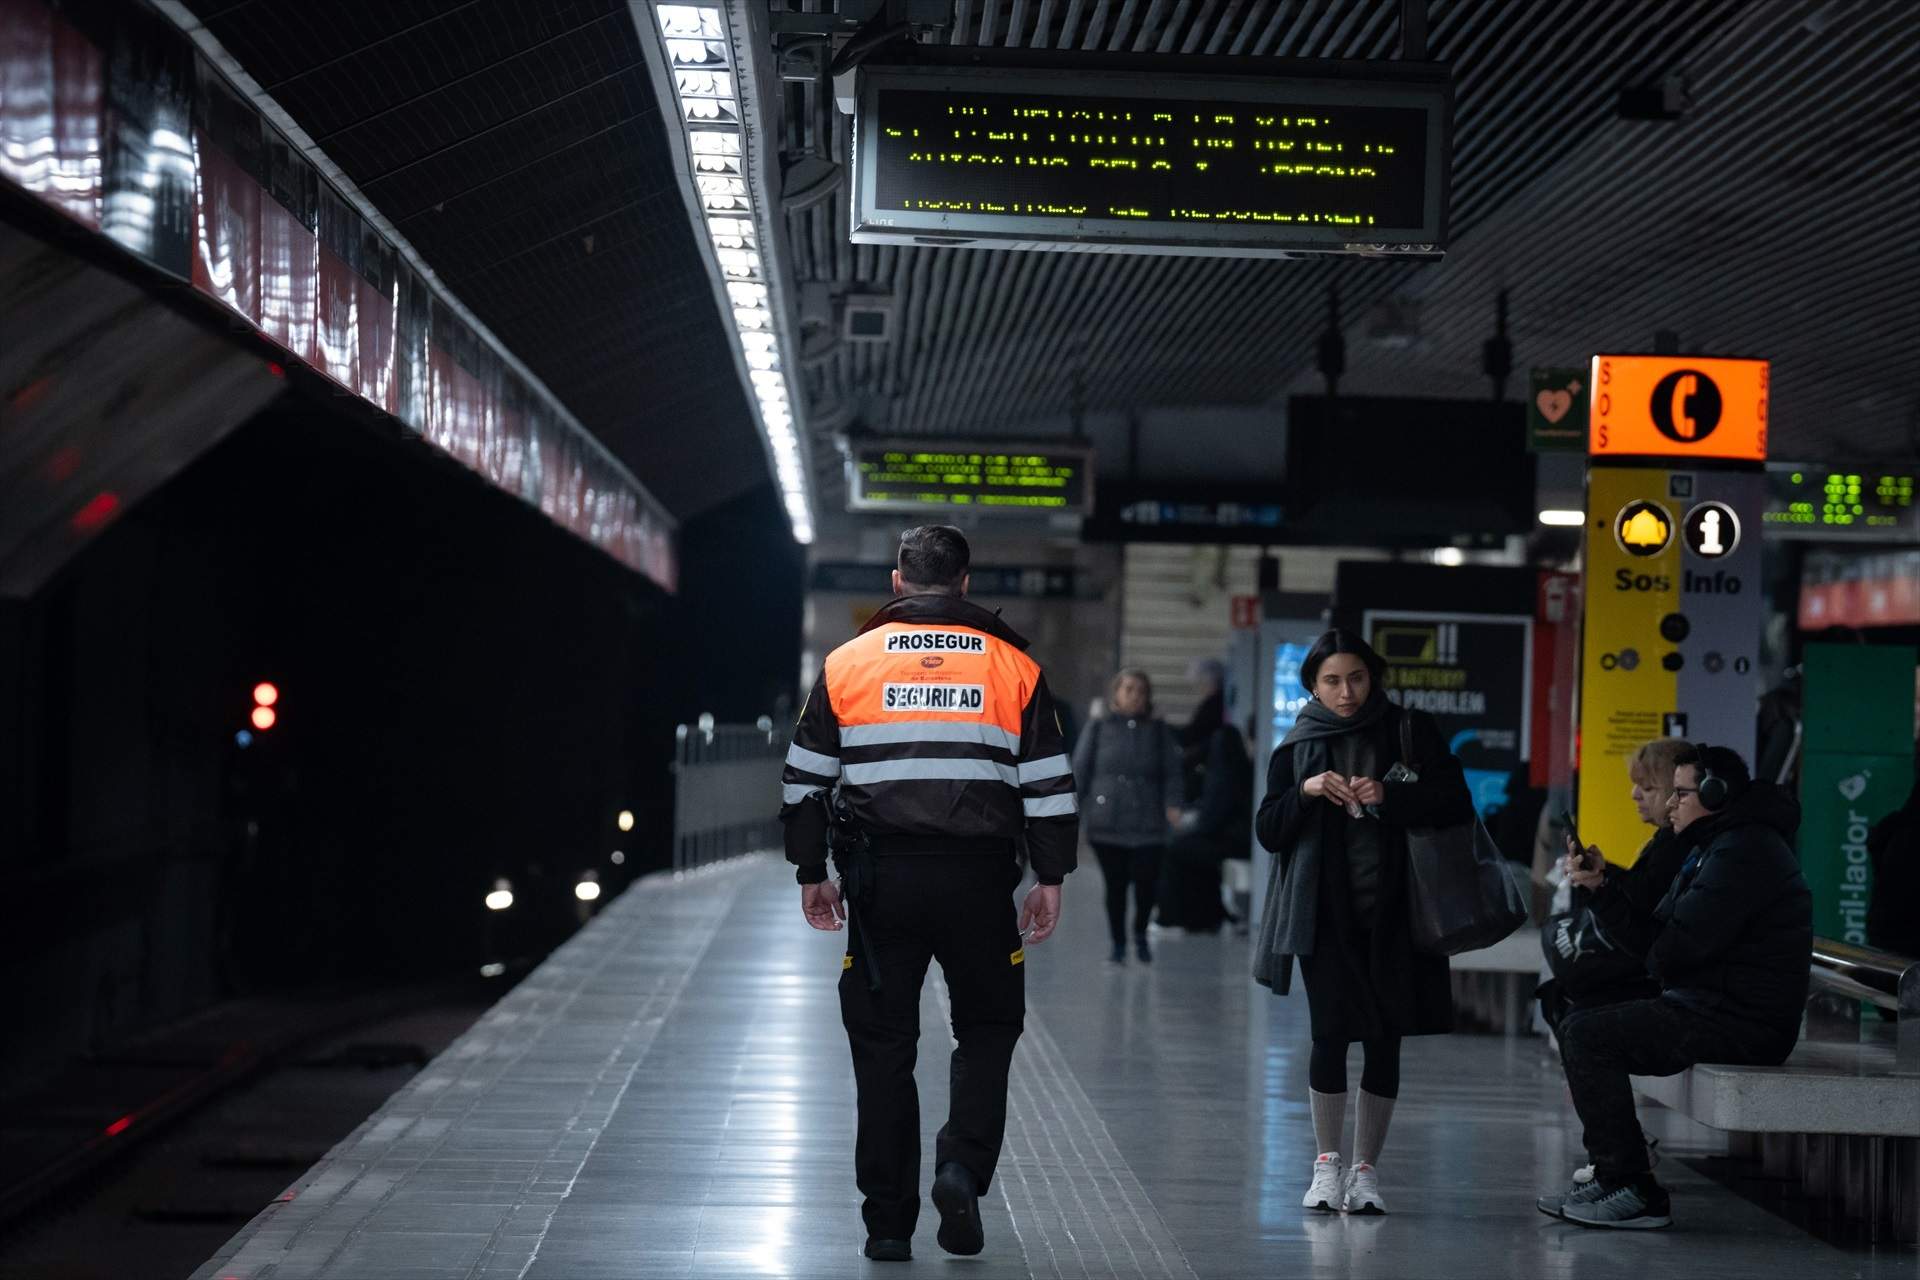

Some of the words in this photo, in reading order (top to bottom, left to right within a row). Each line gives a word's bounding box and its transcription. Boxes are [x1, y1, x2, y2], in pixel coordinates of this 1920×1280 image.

[1598, 361, 1611, 449] SOS
[1615, 567, 1671, 592] Sos
[1684, 569, 1742, 595] Info
[887, 633, 983, 651] PROSEGUR
[886, 686, 982, 708] SEGURIDAD
[1403, 689, 1486, 715] PROBLEM
